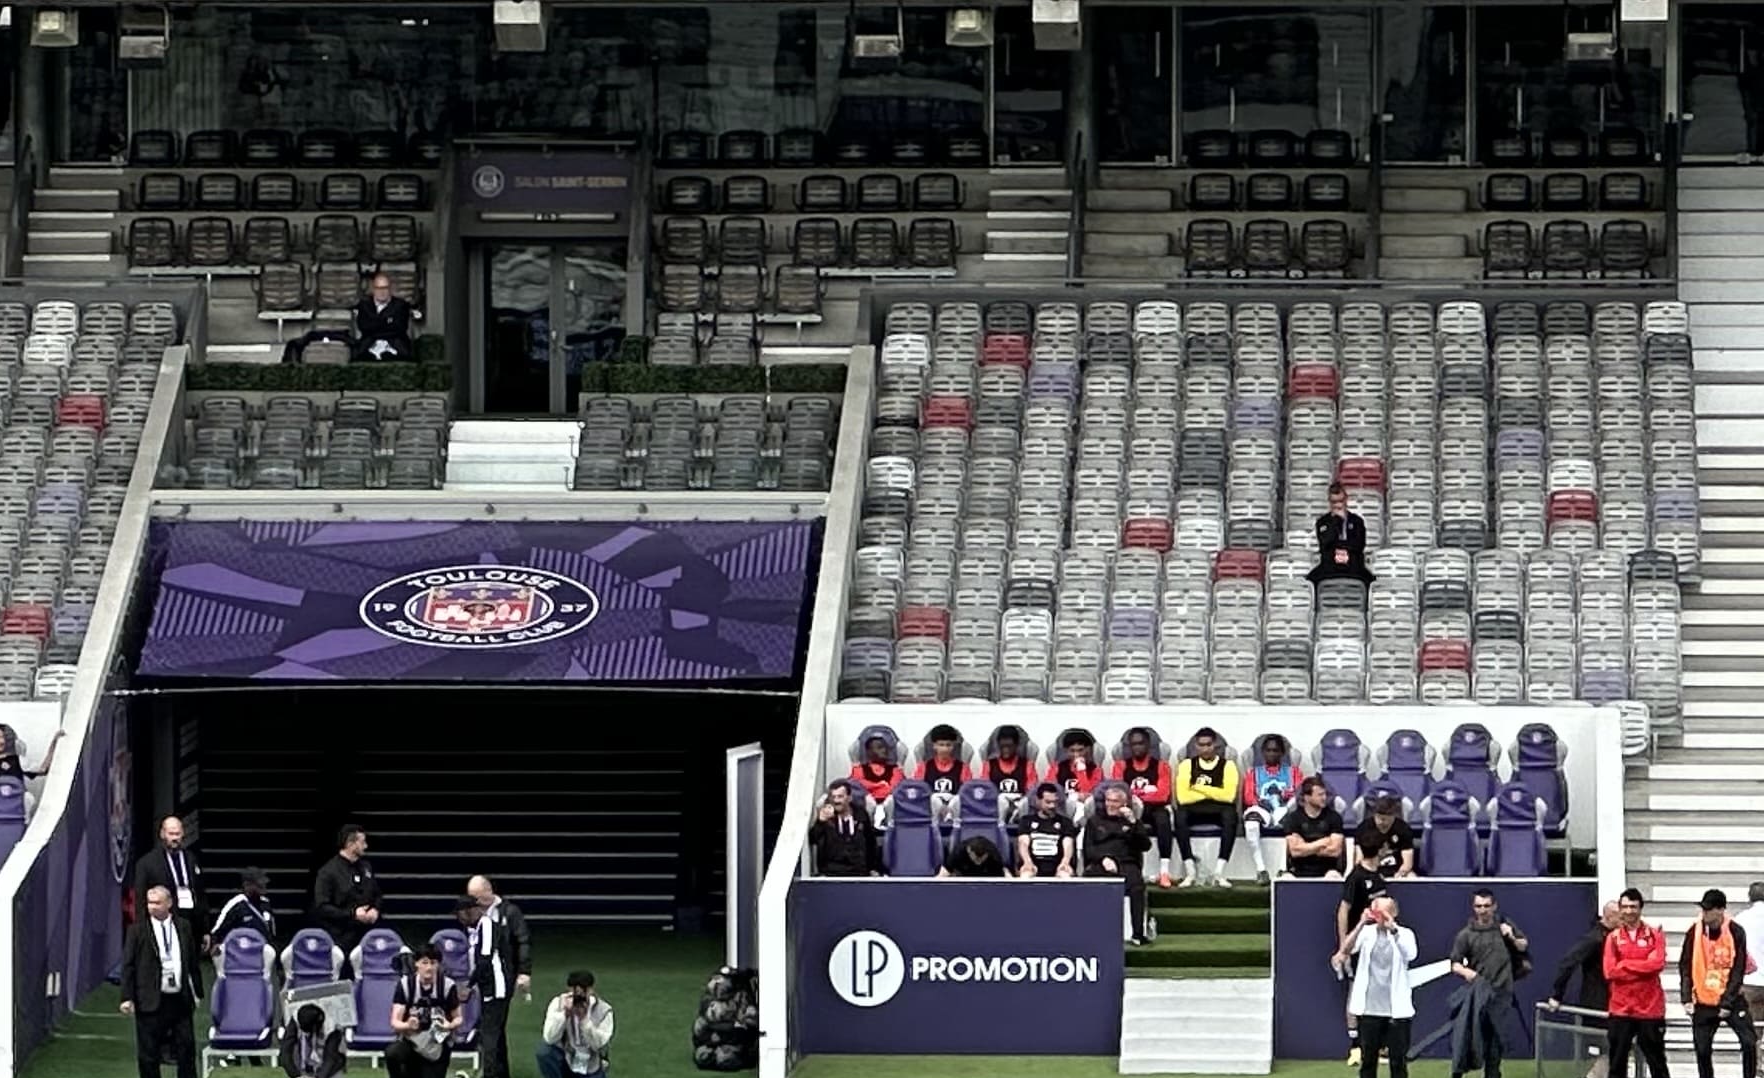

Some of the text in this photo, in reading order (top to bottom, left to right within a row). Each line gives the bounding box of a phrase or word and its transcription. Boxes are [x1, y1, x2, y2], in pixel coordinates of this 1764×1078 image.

[407, 570, 560, 590] TOULOUSE
[387, 619, 567, 644] FOOTBALL CLUB
[852, 940, 1098, 997] LP PROMOTION
